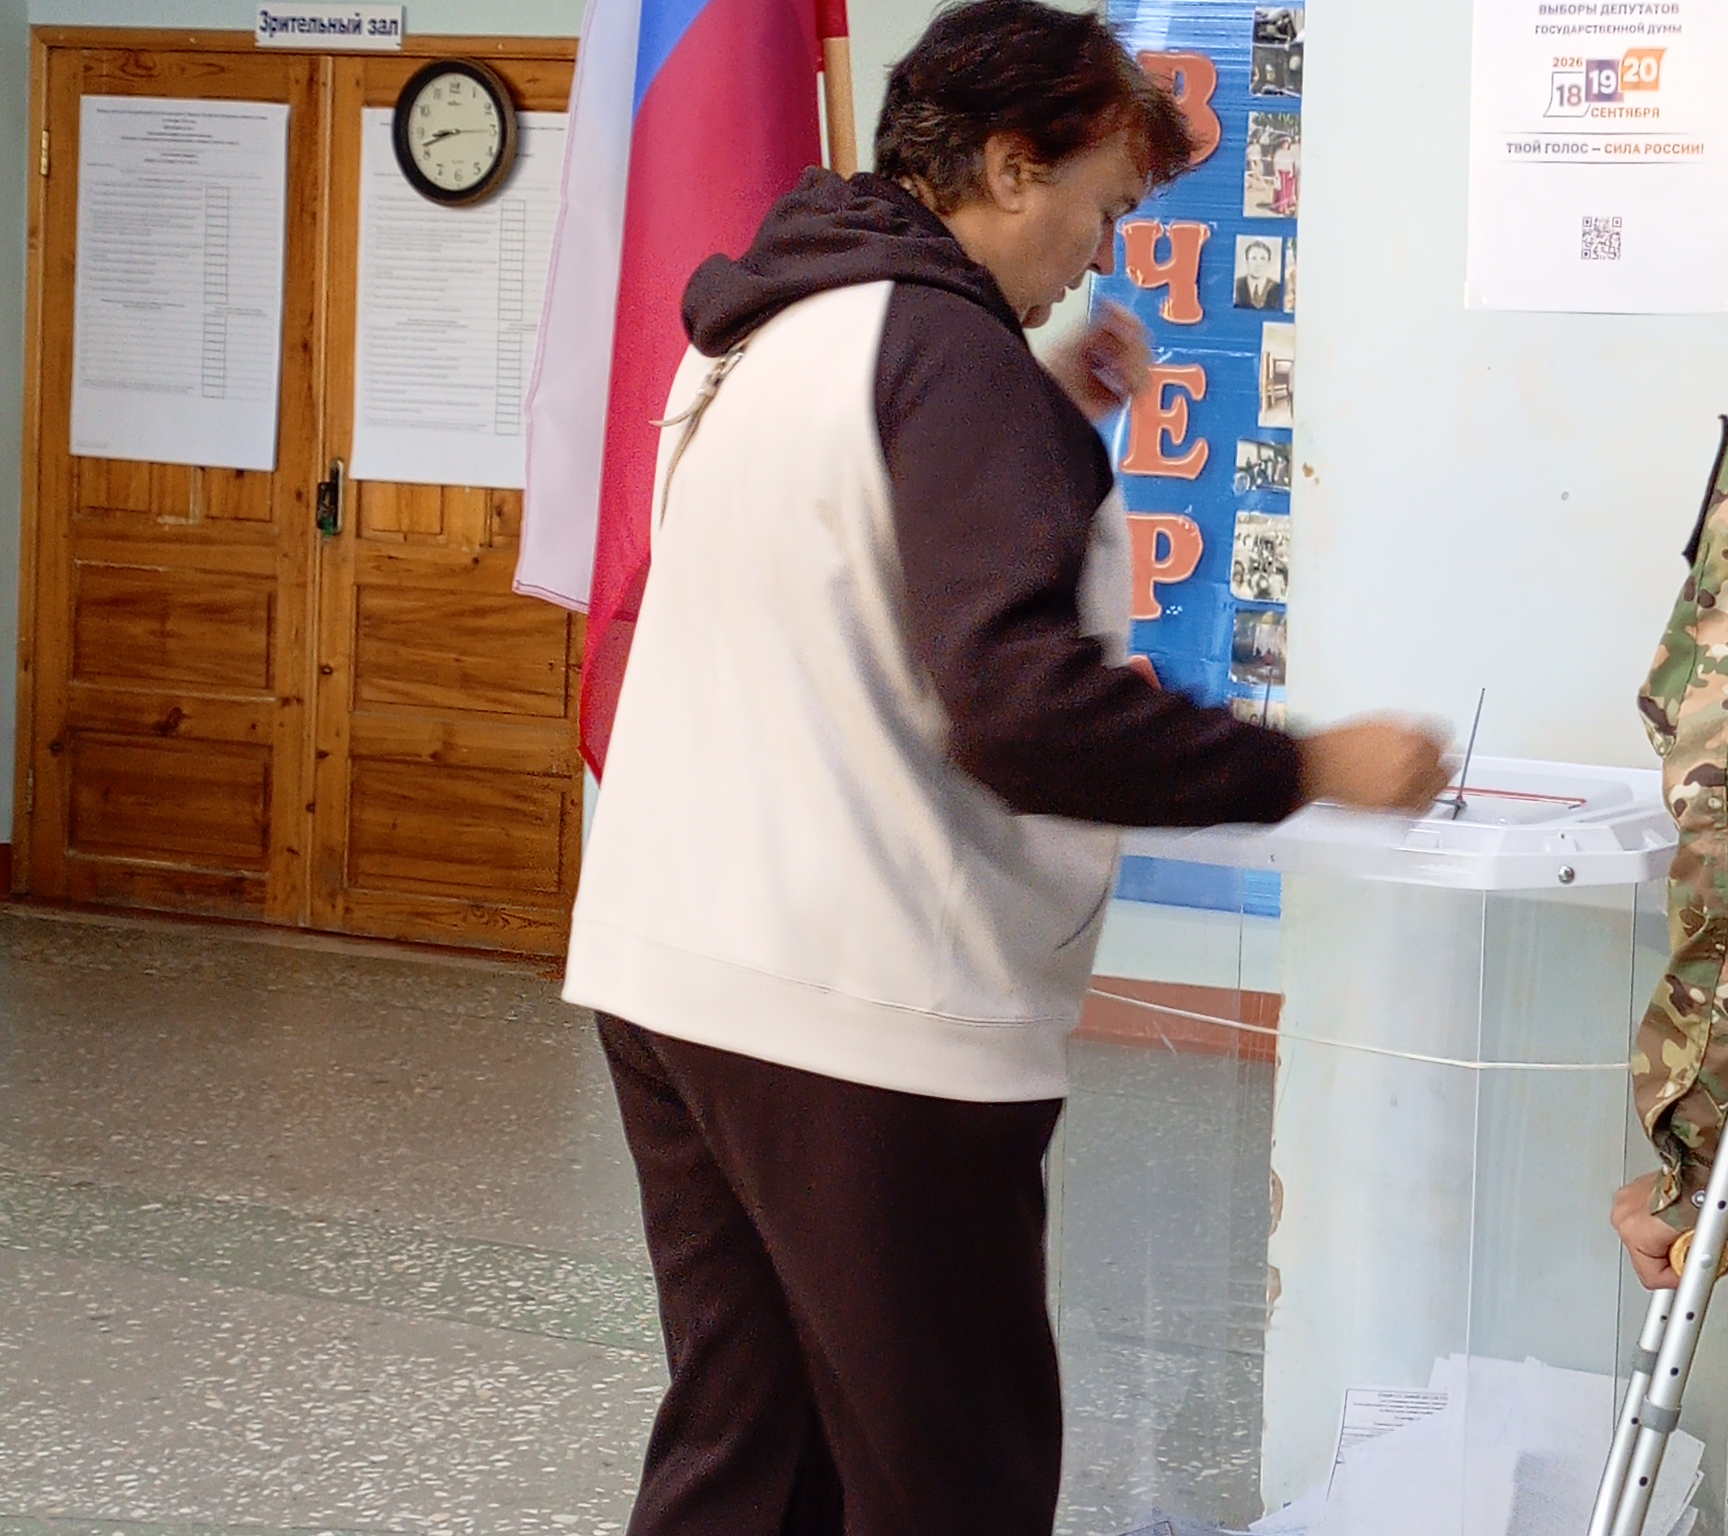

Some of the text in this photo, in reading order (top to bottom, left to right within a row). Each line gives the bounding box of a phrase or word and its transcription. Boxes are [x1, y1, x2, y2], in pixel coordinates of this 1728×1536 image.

[1538, 3, 1680, 17] ВЫБОРЫ ДЕПУТАТОВ
[259, 9, 398, 38] Зрительный зал
[1535, 22, 1682, 35] ГОСУДАРСТВЕННОЙ ДУМЫ
[1553, 57, 1583, 67] 2026
[1555, 57, 1658, 107] 18 19 20
[1591, 107, 1660, 118] СЕНТЯБРЯ
[1506, 141, 1541, 154] ТВОЙ
[1545, 143, 1589, 154] ГОЛОС
[1604, 143, 1641, 155] СИЛА
[1644, 143, 1704, 155] РОССИИ!
